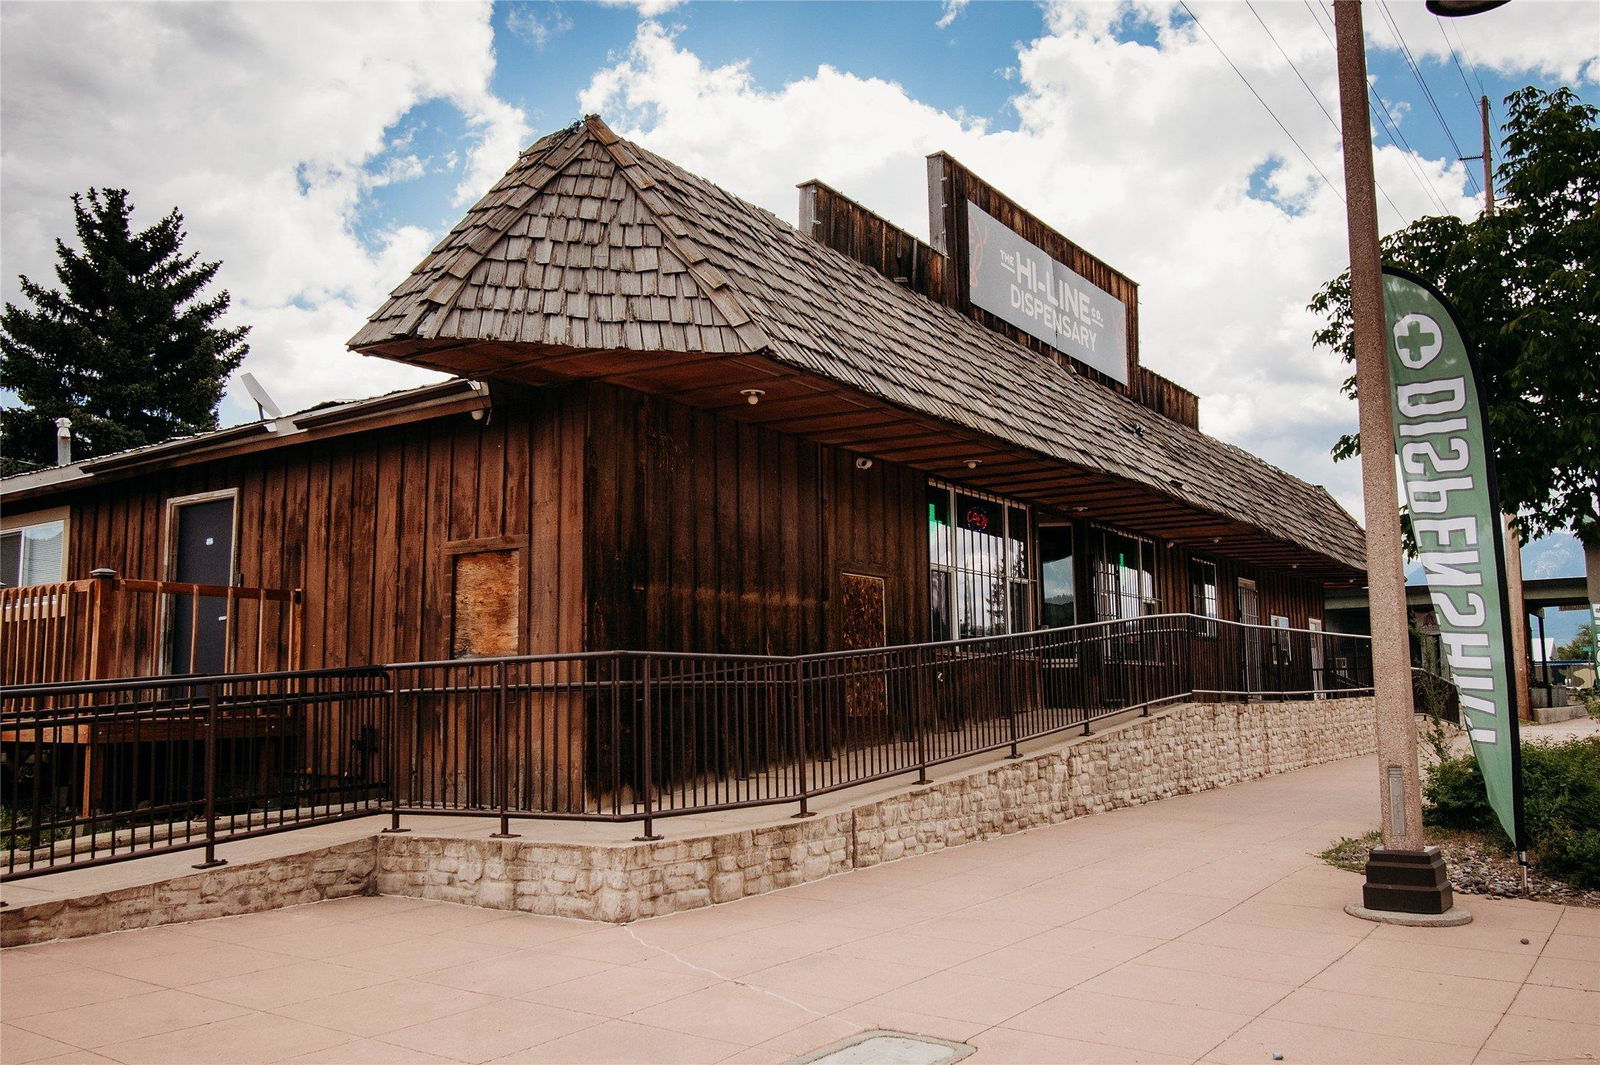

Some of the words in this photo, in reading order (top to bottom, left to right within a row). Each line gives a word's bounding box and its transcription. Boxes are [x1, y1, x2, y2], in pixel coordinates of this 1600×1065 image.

[1000, 249, 1015, 266] THE
[1016, 251, 1092, 325] HI-LINE
[1010, 283, 1097, 353] DISPENSARY
